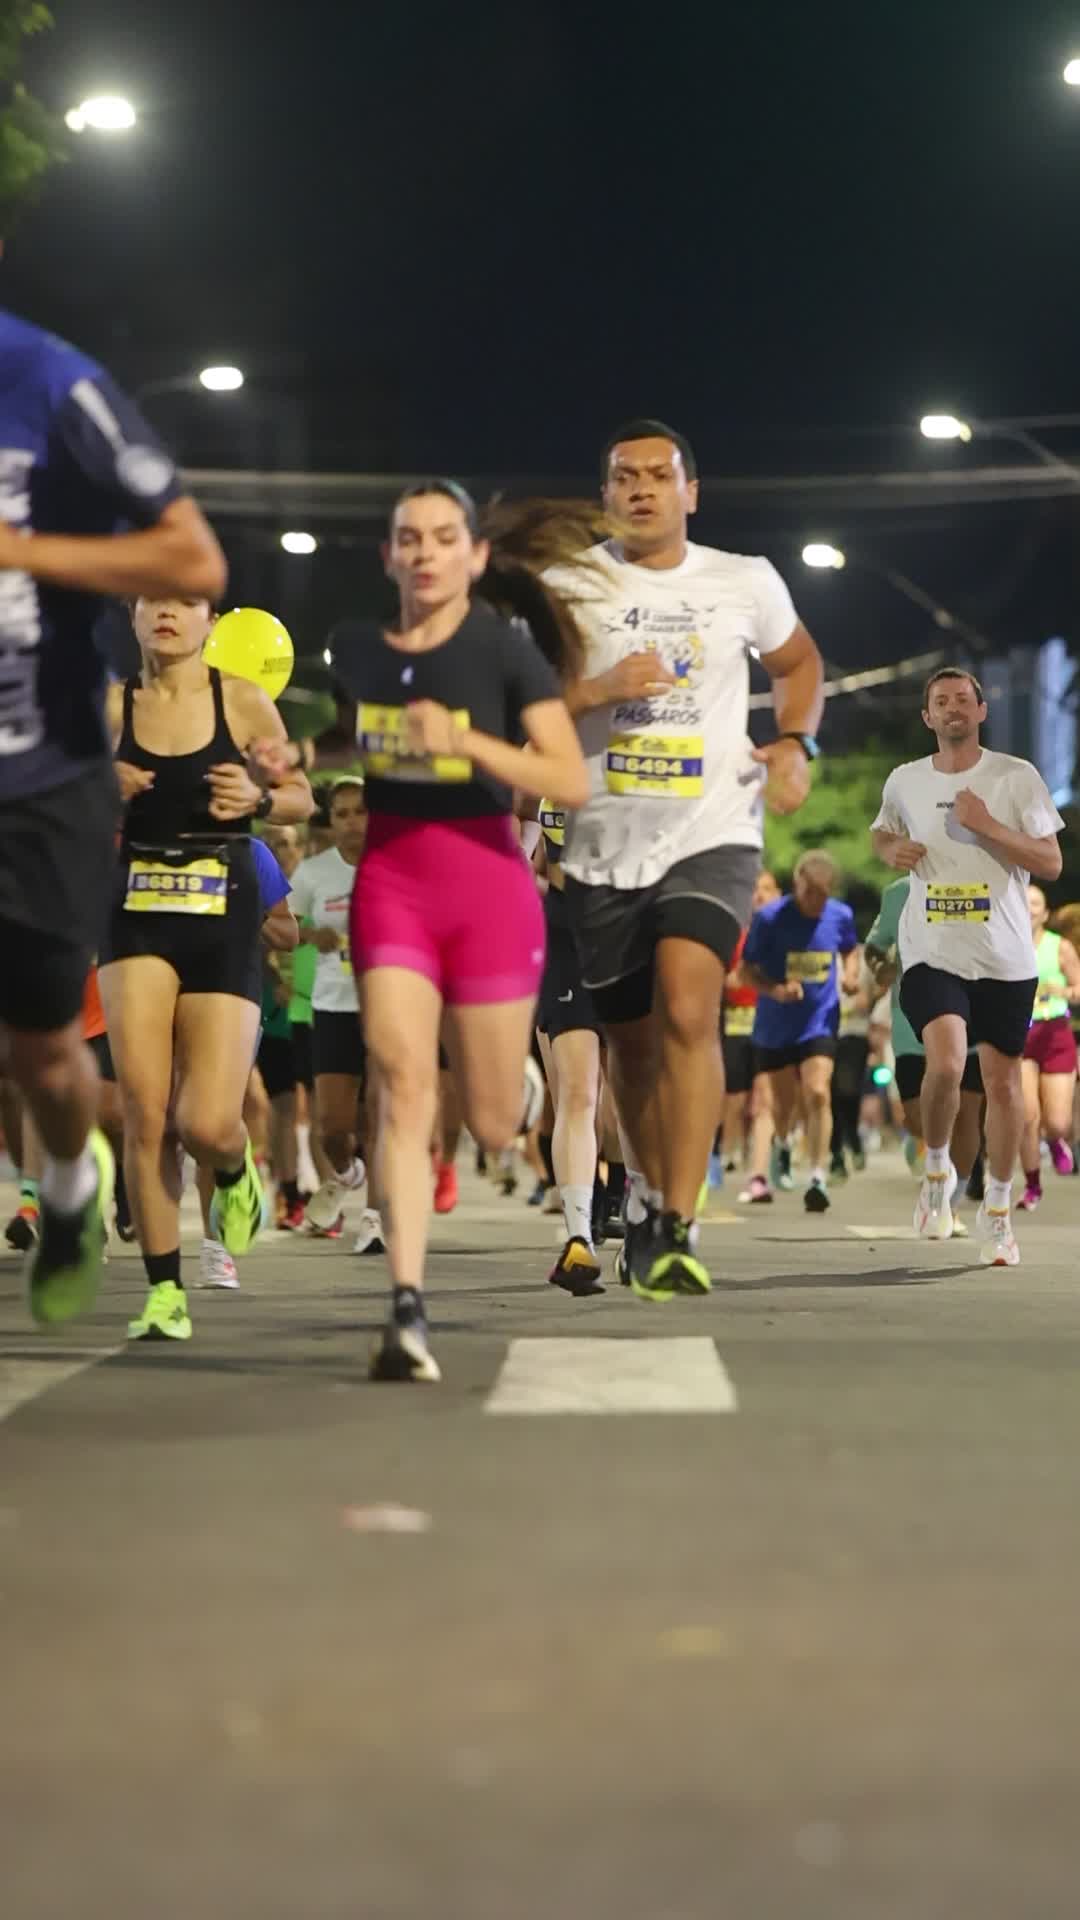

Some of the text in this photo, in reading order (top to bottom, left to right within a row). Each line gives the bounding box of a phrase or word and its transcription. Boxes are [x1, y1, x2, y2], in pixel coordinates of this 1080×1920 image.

[625, 757, 683, 775] 6494
[150, 874, 202, 892] 6819
[937, 899, 974, 911] 6270
